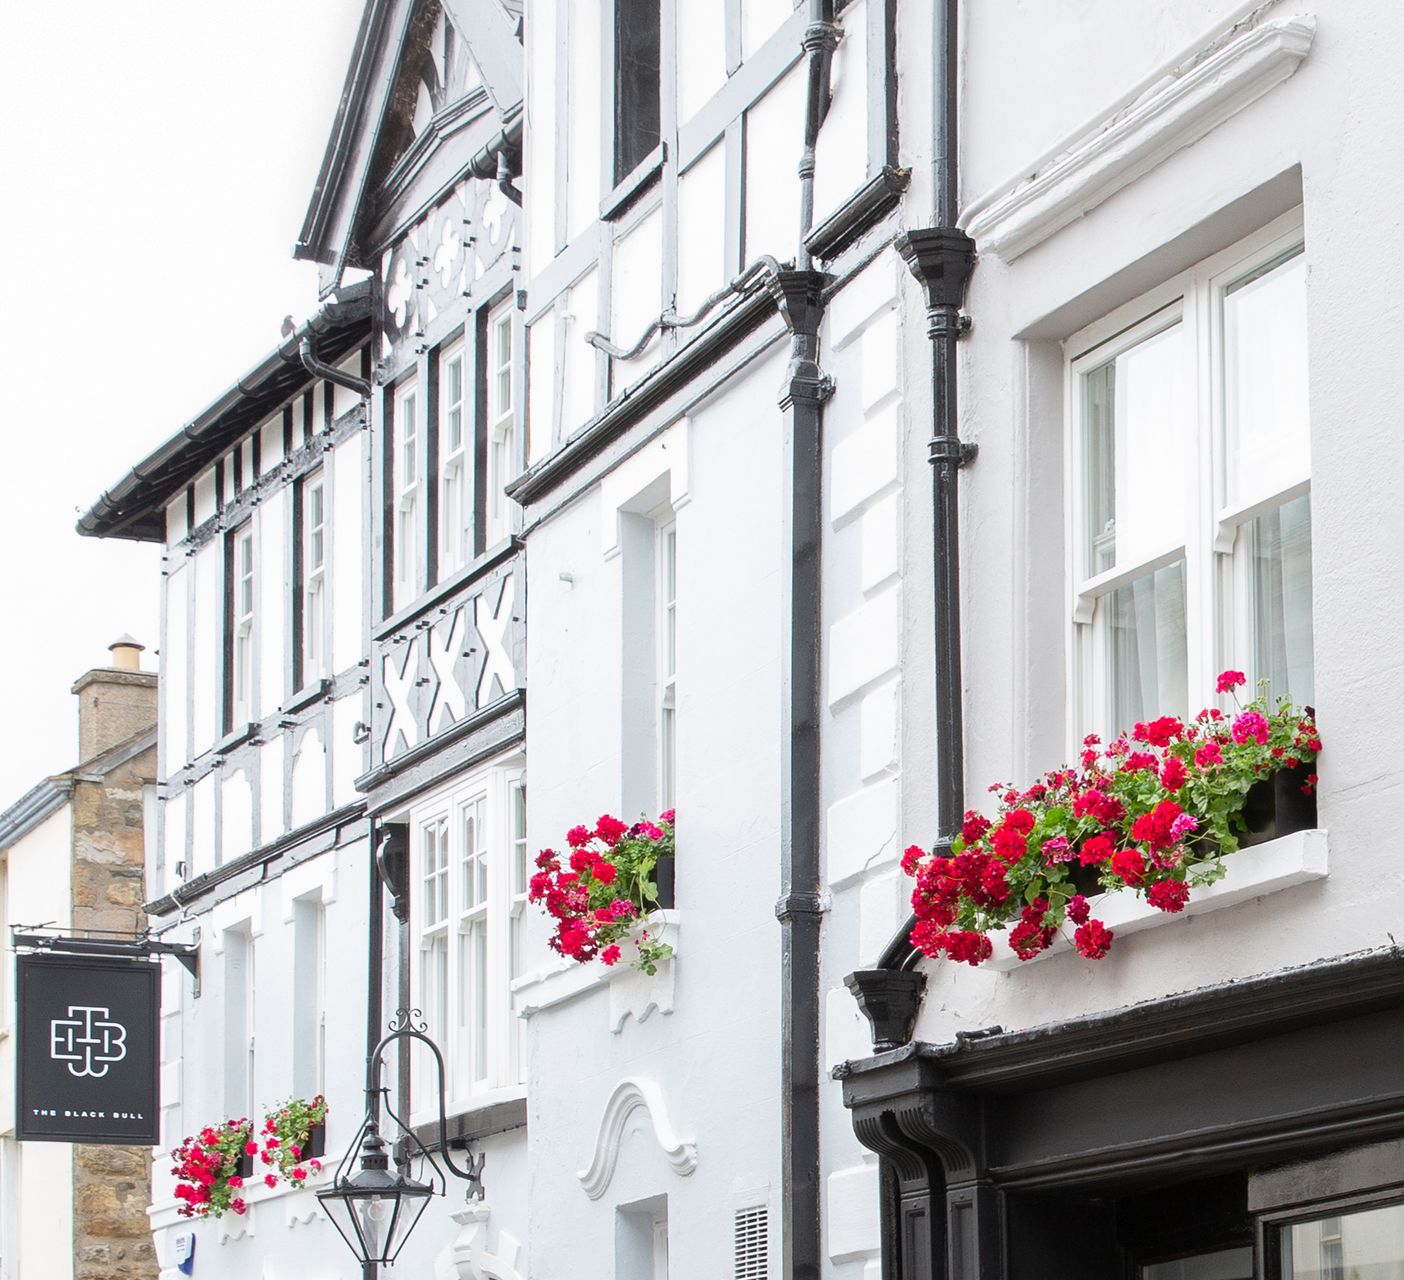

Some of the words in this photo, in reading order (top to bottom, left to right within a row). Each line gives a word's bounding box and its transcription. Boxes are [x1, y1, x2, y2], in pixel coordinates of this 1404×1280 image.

[32, 1108, 57, 1117] THE
[64, 1110, 105, 1118] BLACK
[112, 1111, 144, 1120] BULL
